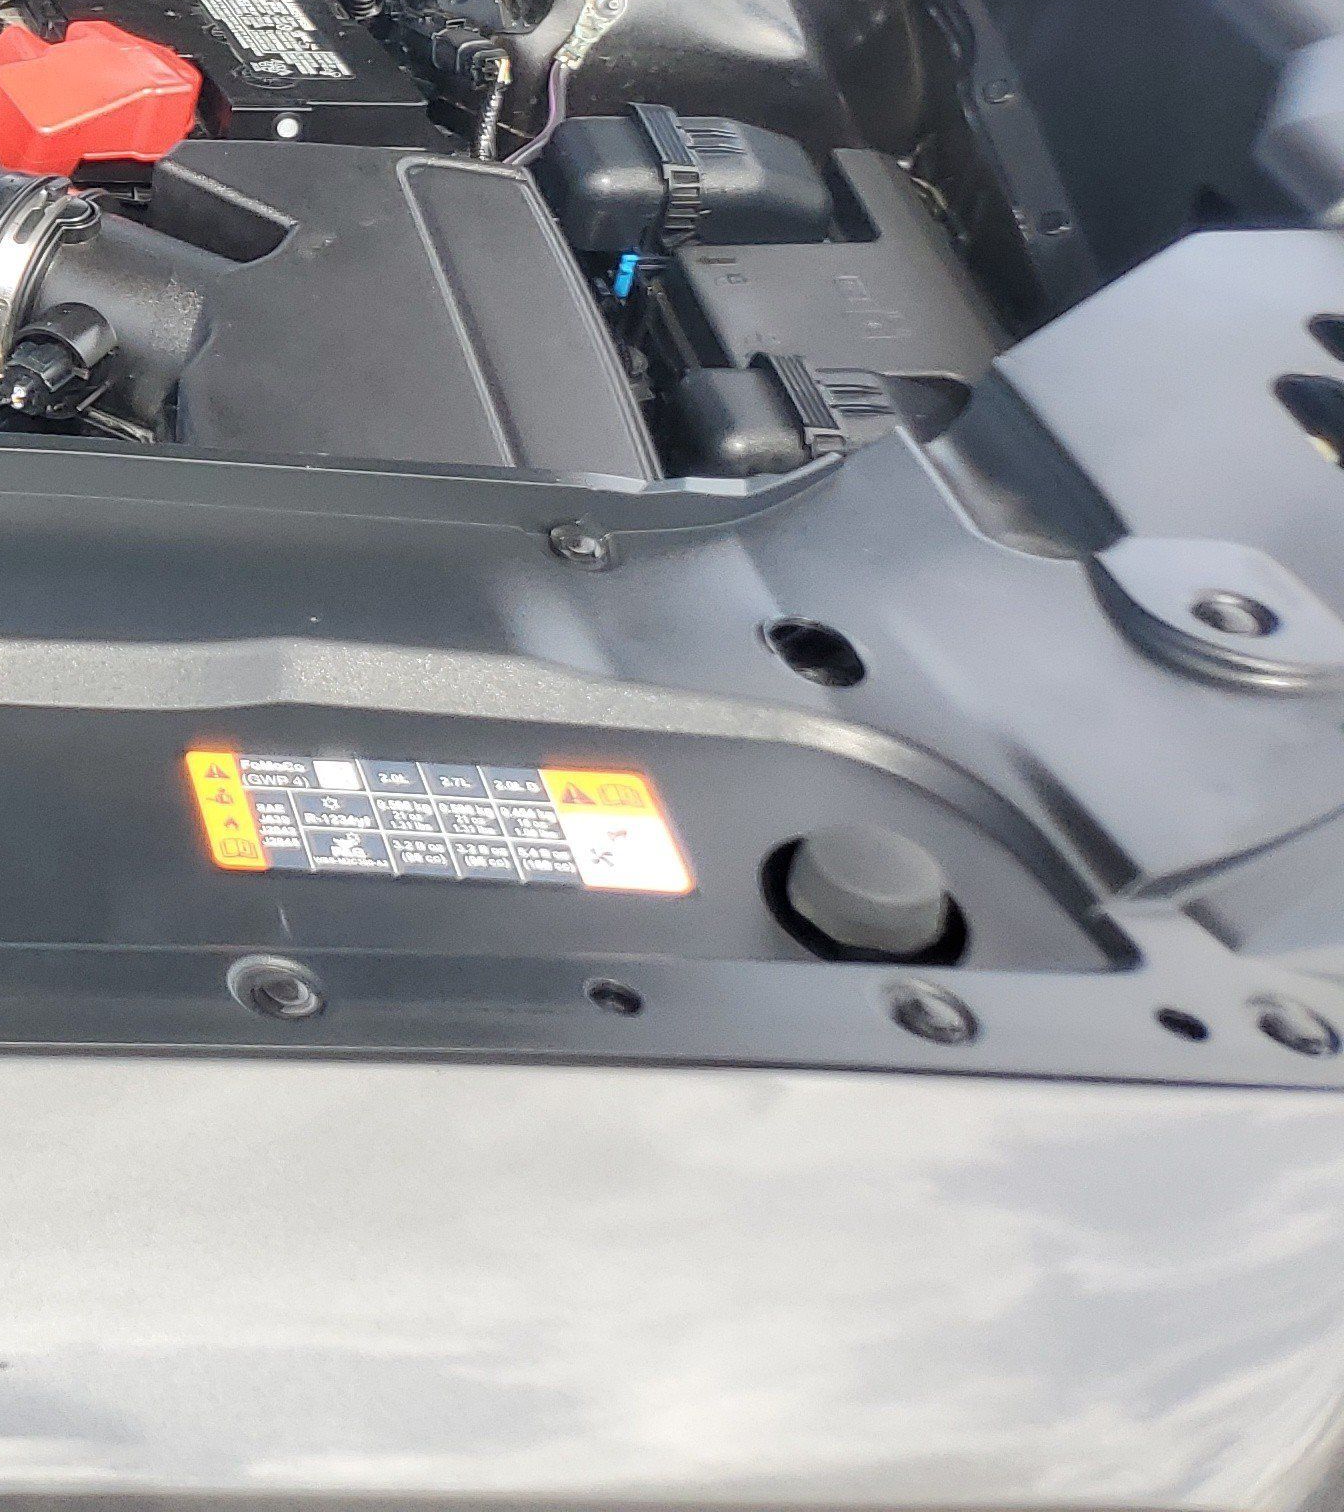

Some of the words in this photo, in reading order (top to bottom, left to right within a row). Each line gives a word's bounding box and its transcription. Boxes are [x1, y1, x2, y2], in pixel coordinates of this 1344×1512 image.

[240, 760, 306, 772] FoMoCo
[242, 773, 289, 786] (GWP
[378, 773, 408, 783] 2.0L
